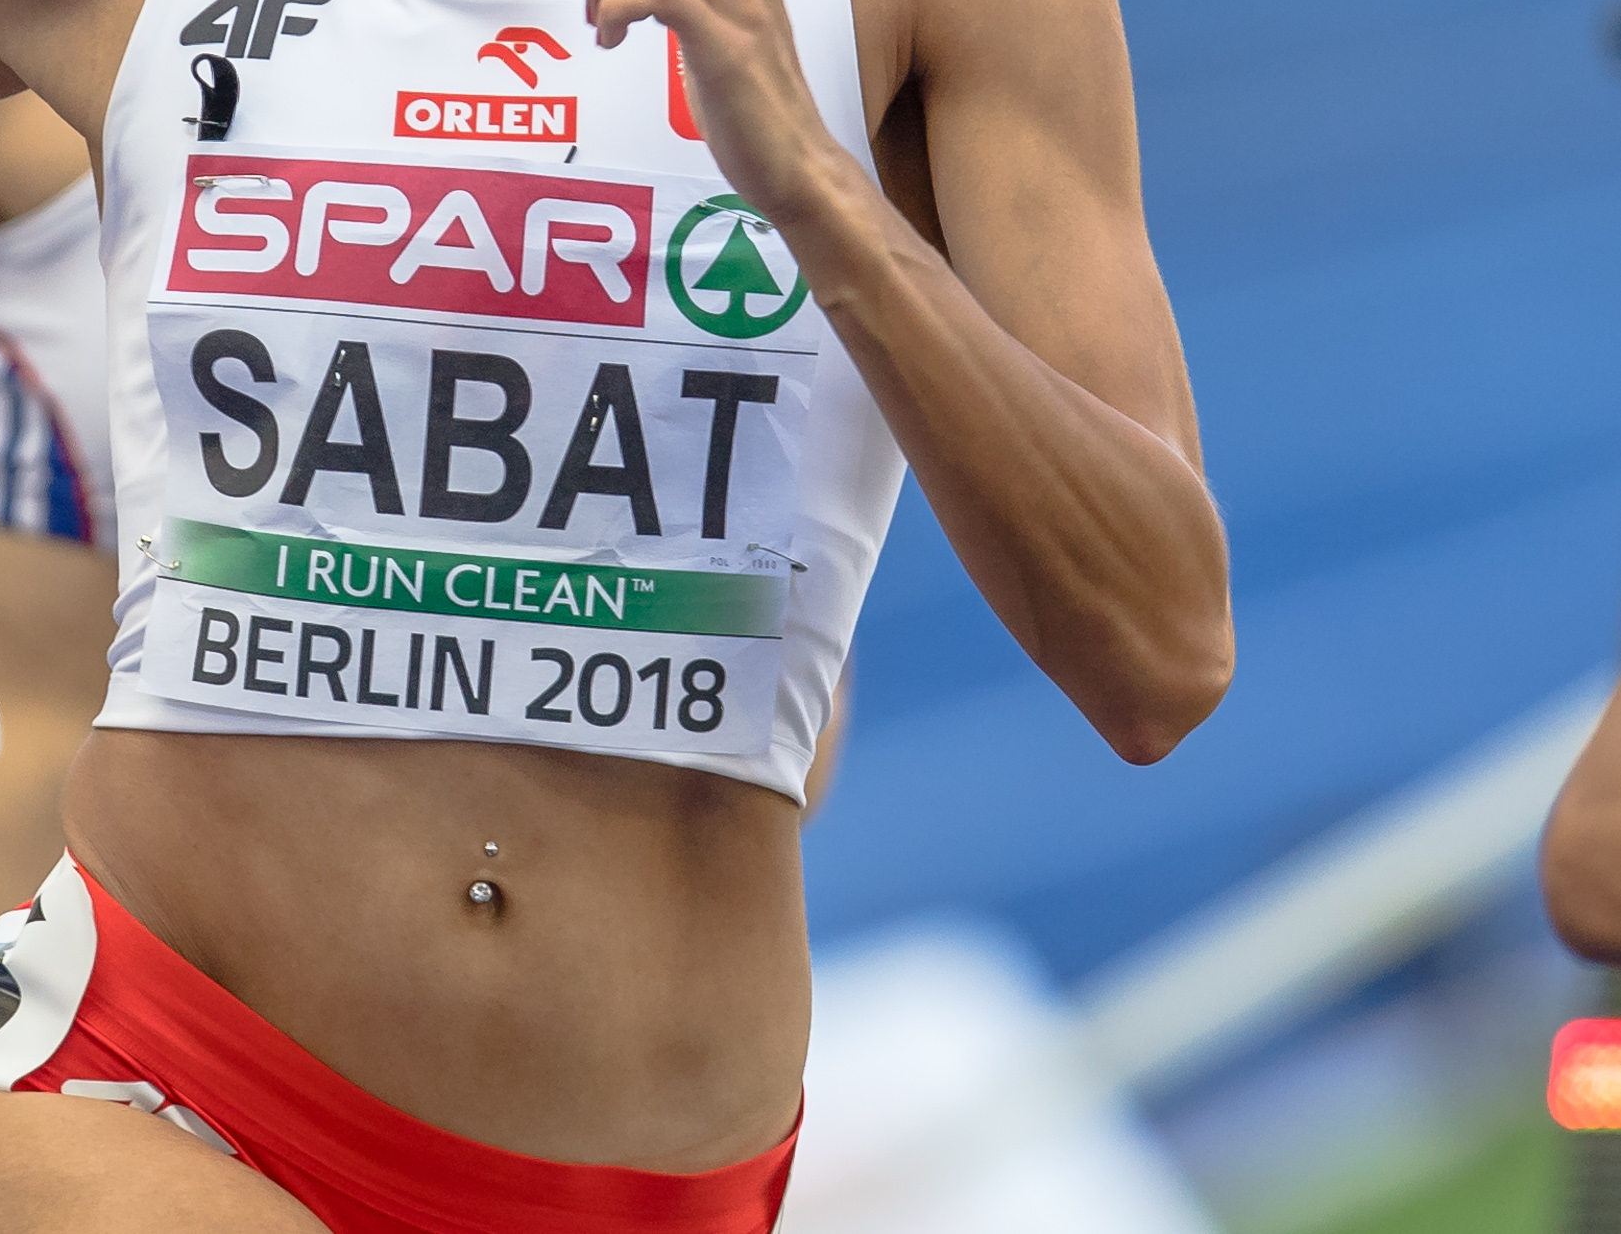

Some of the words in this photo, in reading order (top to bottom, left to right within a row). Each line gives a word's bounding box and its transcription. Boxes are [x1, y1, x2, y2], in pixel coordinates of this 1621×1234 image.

[404, 98, 567, 136] ORLEN
[185, 175, 637, 304] SPAR
[189, 328, 779, 540] SABAT
[276, 545, 289, 588] I
[306, 549, 426, 604] RUN
[191, 607, 496, 716] BERLIN
[524, 646, 727, 733] 2018
